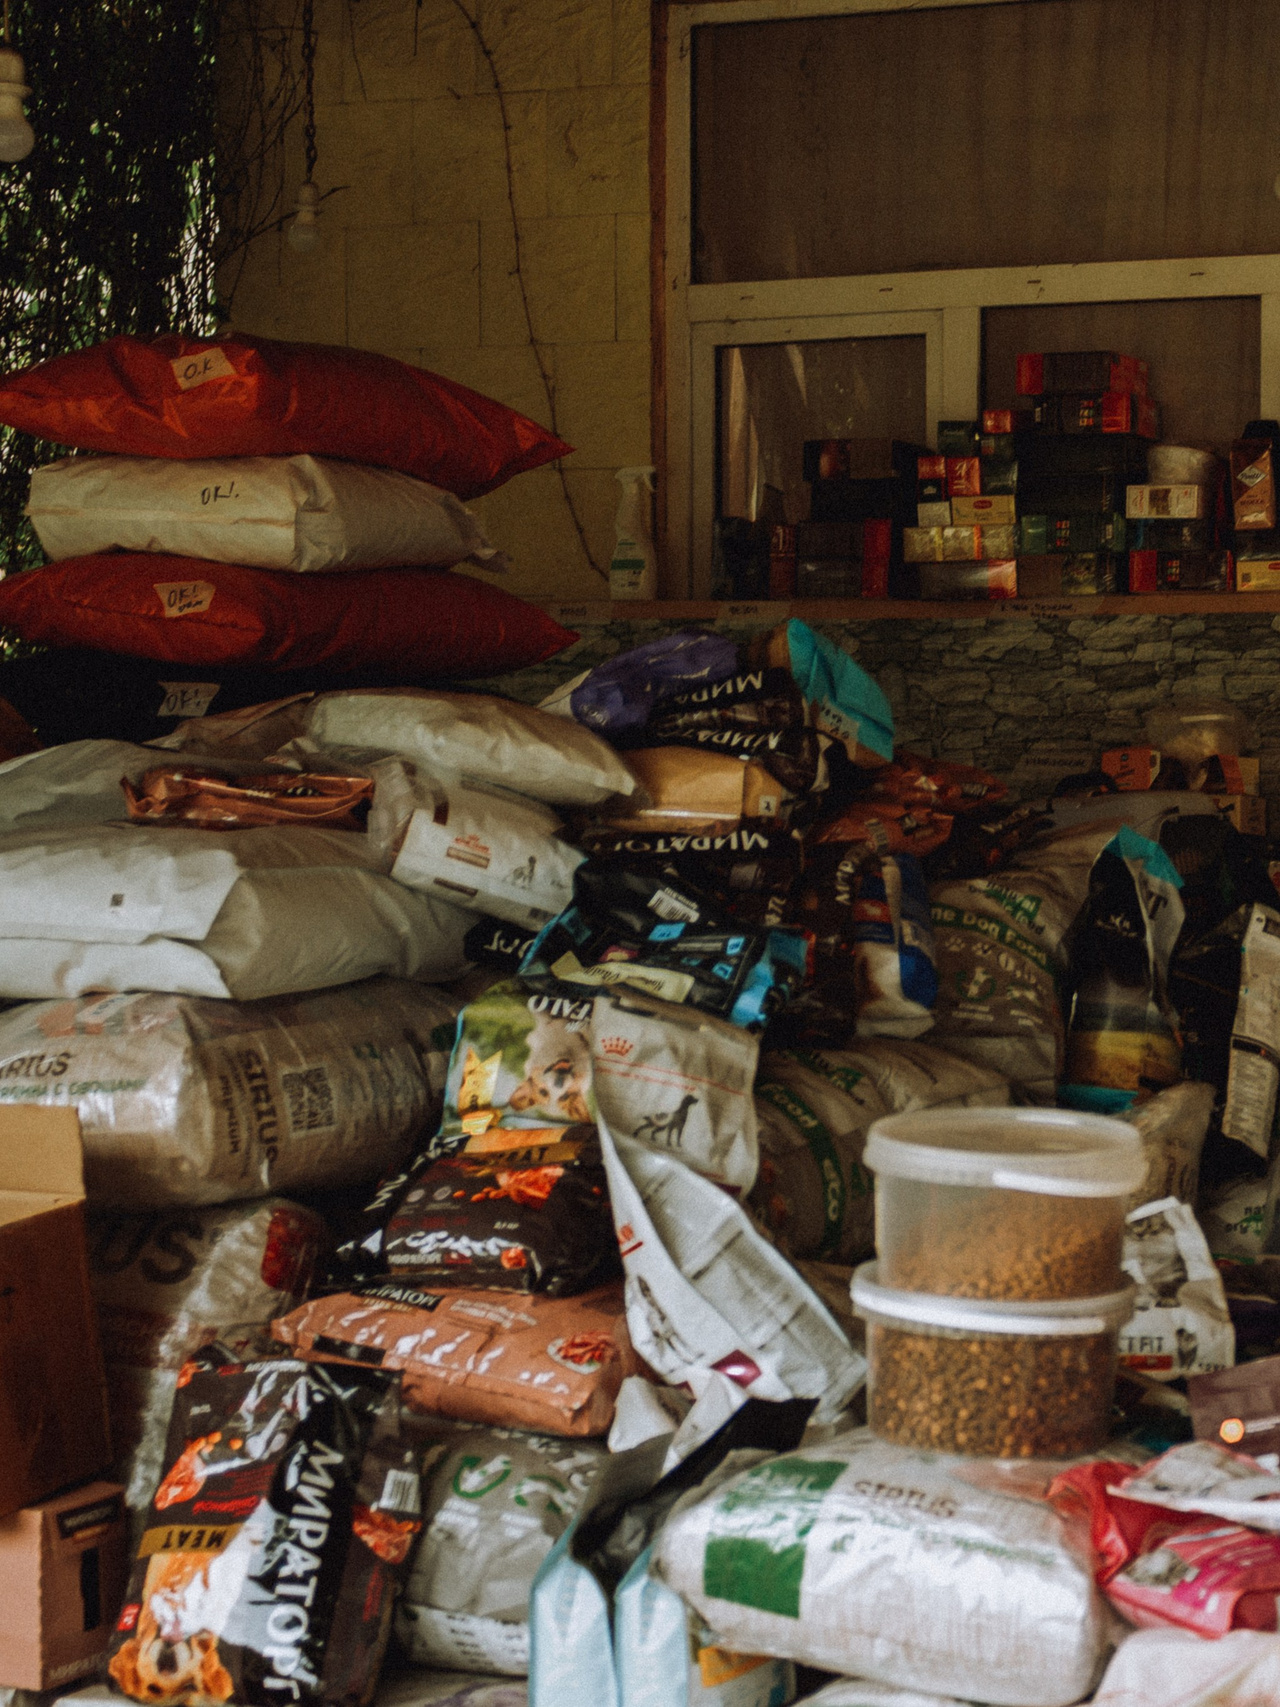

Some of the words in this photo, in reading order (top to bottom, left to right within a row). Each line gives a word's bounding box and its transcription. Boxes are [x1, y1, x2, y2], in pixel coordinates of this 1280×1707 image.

[962, 913, 1001, 940] Dog
[1005, 929, 1048, 966] Food
[161, 1527, 227, 1550] MEAT
[262, 1439, 345, 1700] МИРАТОРГ
